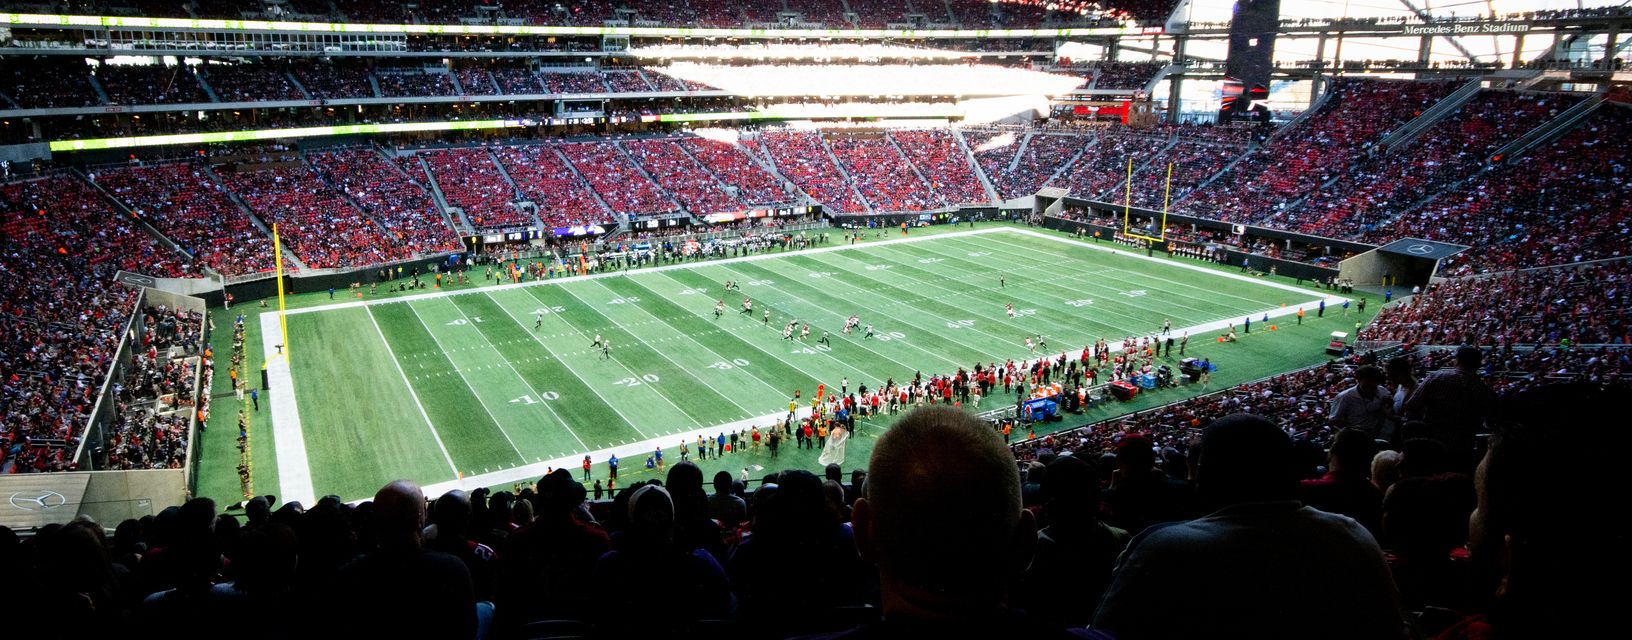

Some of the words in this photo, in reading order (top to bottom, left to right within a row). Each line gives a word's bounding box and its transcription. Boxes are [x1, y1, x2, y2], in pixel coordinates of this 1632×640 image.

[1403, 24, 1480, 35] Mercedes-Benz
[1482, 23, 1529, 33] Stadium
[714, 358, 750, 369] 30
[622, 374, 660, 387] 20
[518, 391, 560, 404] 10
